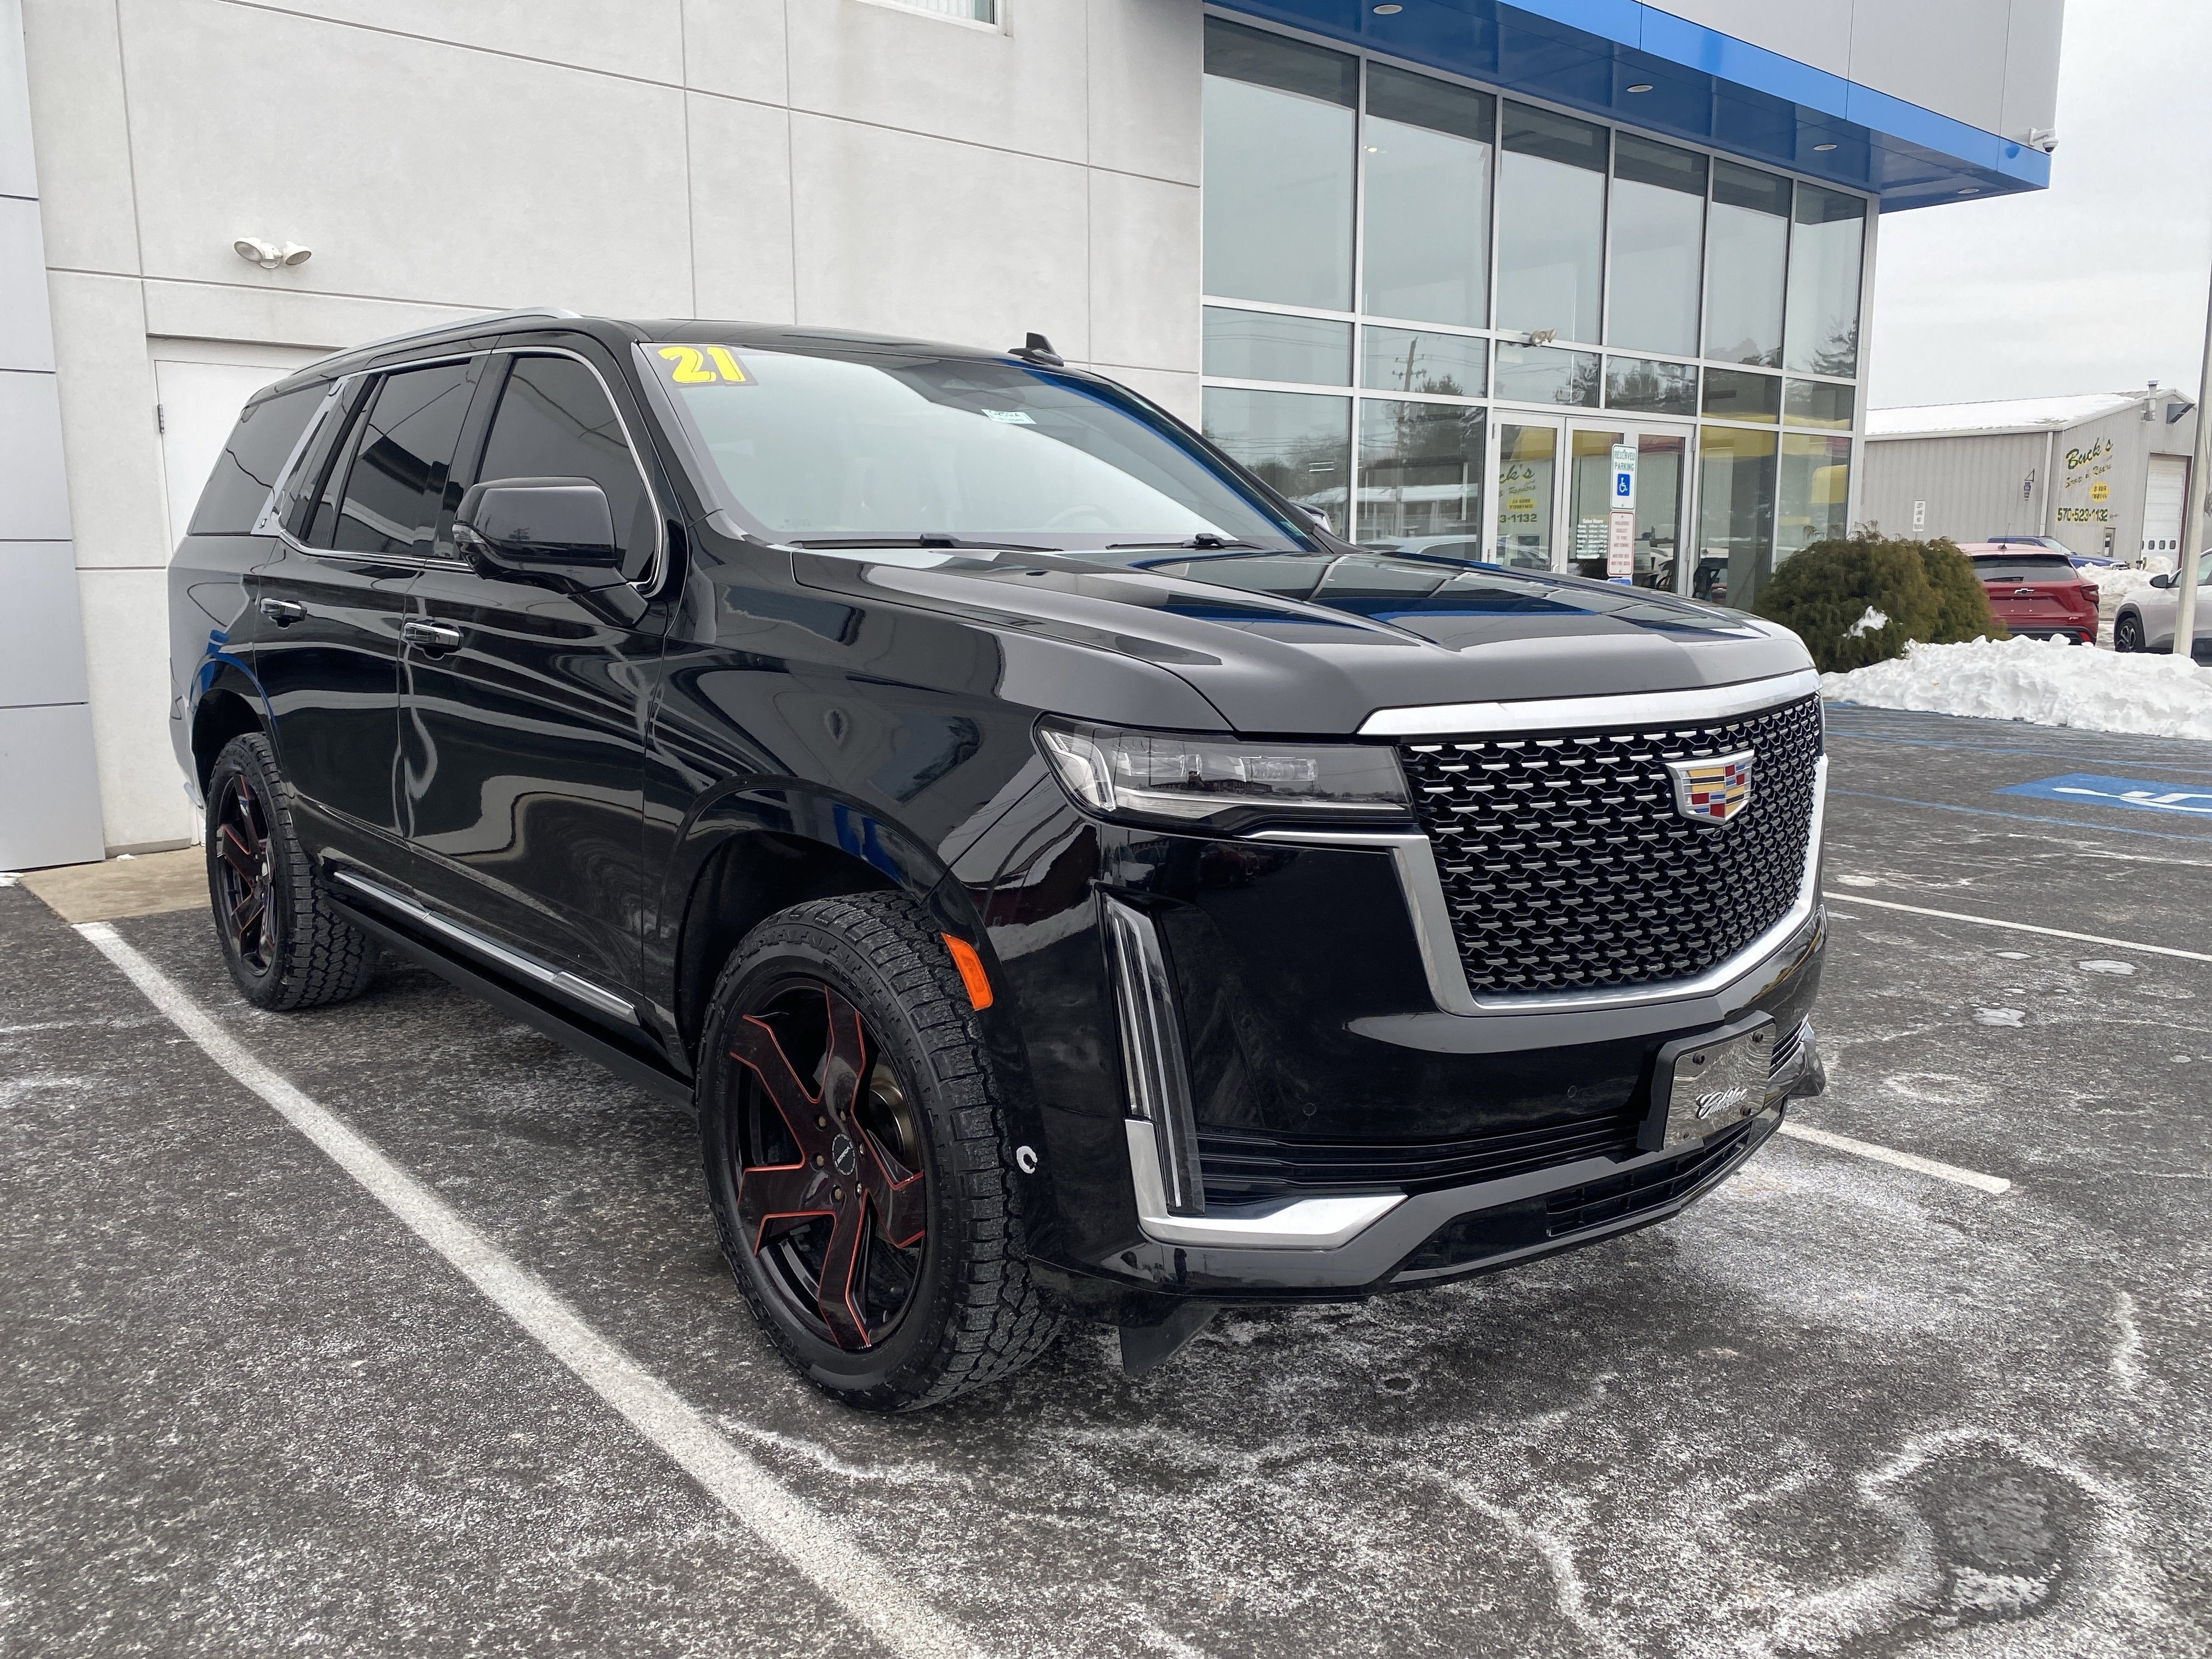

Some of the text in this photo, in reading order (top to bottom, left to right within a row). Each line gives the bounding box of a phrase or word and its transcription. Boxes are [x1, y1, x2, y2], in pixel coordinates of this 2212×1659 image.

[657, 346, 747, 383] 21
[1614, 450, 1635, 461] RESERVED
[2066, 437, 2113, 470] Buck's
[1499, 464, 1535, 484] ck's
[1614, 461, 1634, 472] PARKING
[1499, 513, 1538, 523] 3-1132
